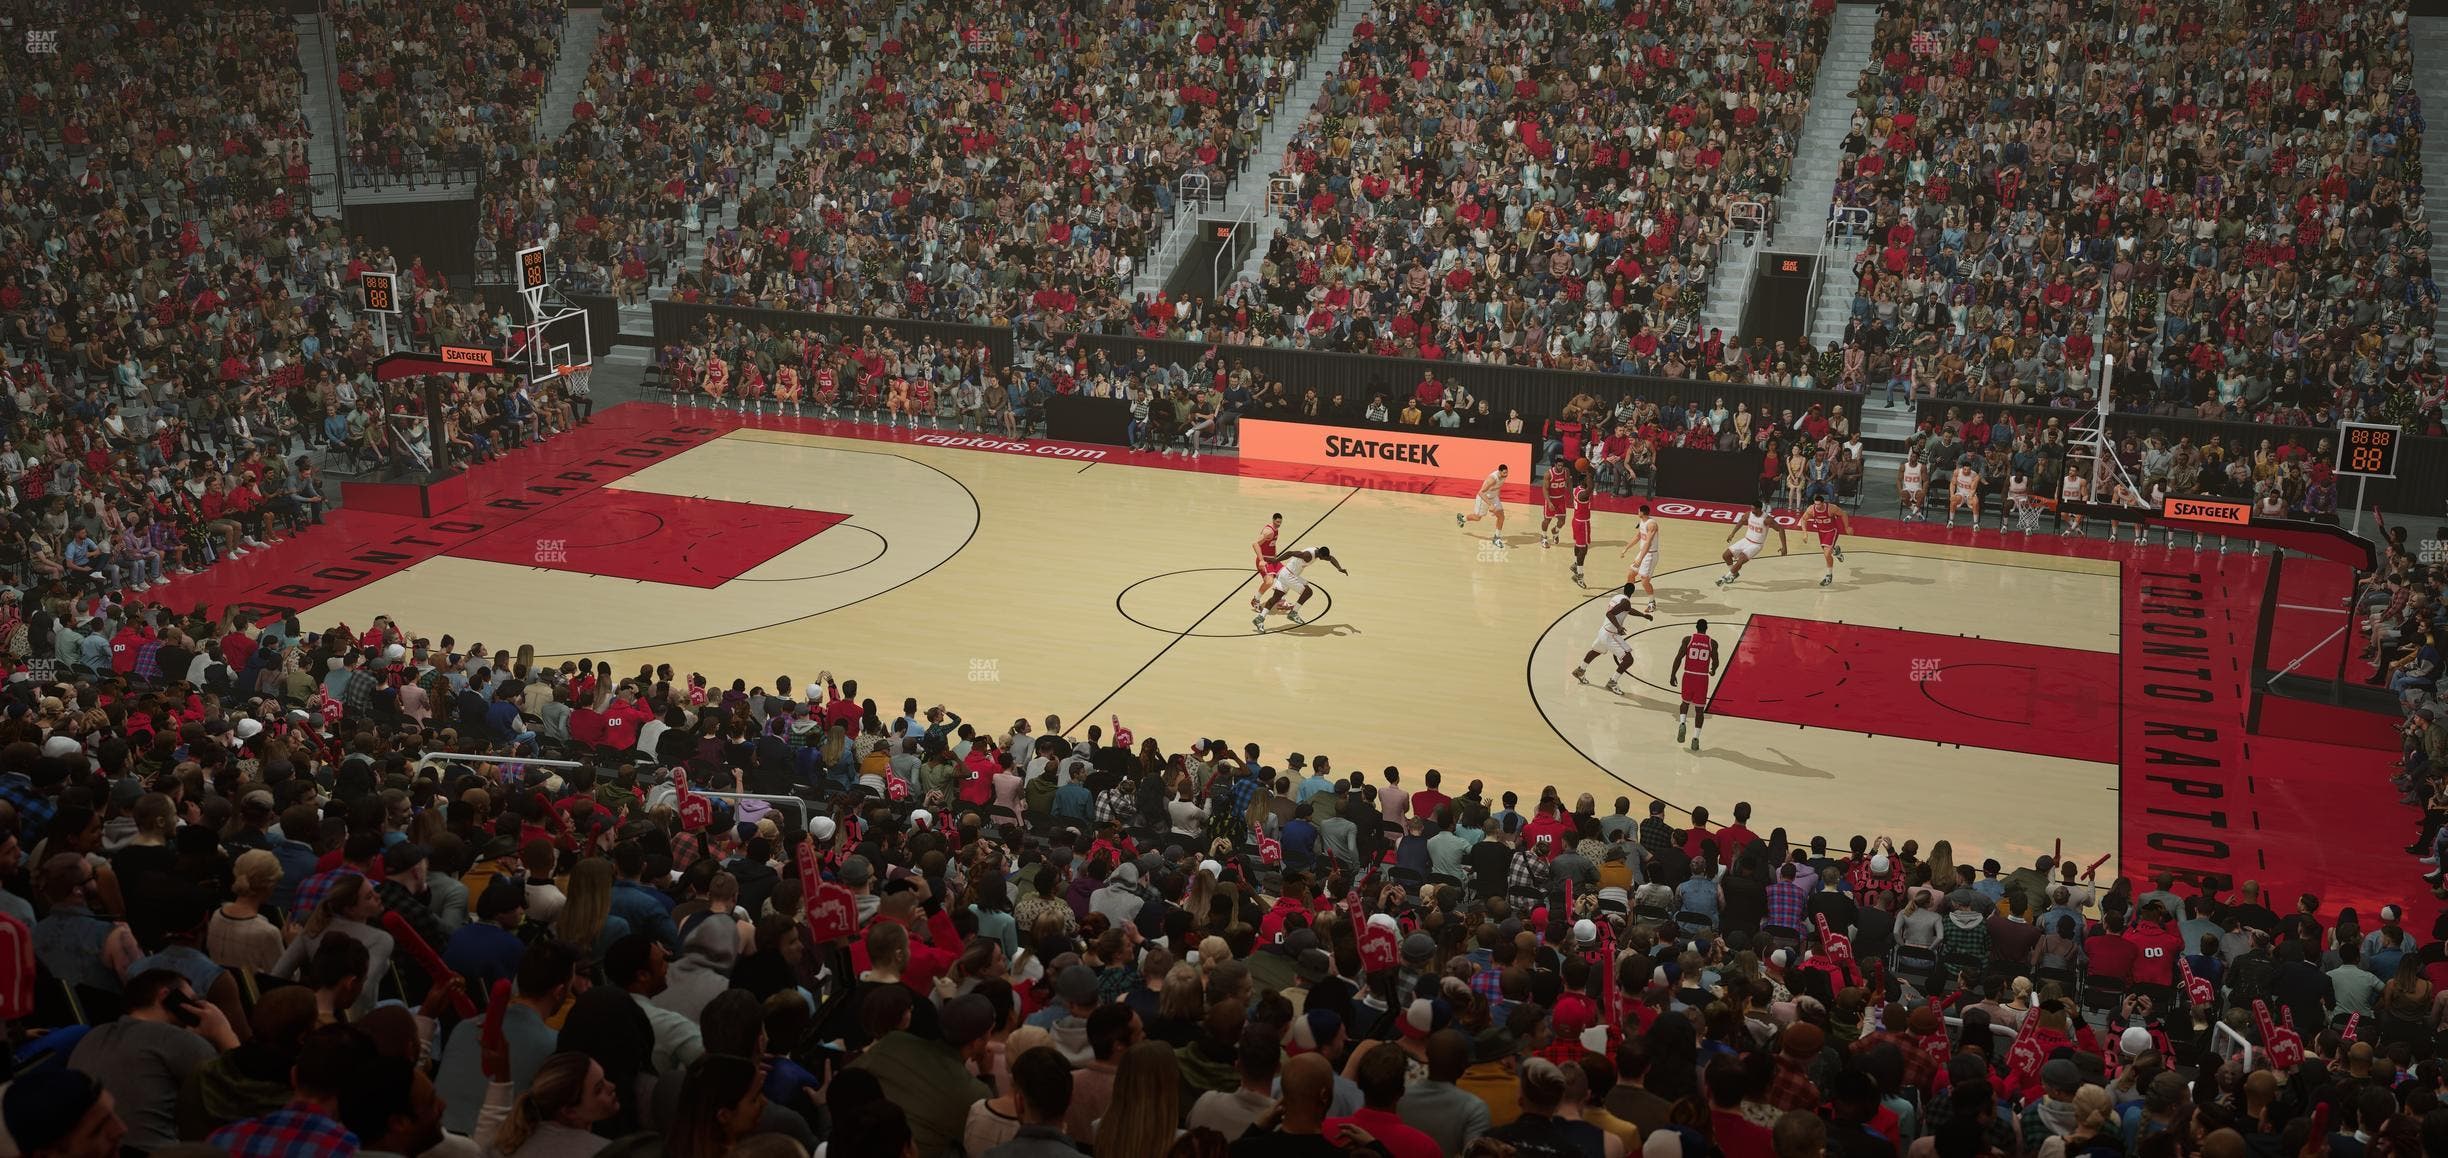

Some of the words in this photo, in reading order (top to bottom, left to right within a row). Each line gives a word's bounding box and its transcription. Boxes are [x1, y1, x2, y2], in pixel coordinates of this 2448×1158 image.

[528, 266, 541, 285] 88
[370, 290, 387, 308] 88
[446, 350, 487, 363] SEATGEEK
[914, 433, 1107, 459] raptors.com
[2352, 430, 2369, 443] 88
[2372, 432, 2389, 445] 88
[1325, 435, 1440, 467] SEATGEEK
[2352, 447, 2382, 471] 88
[486, 426, 716, 511] RAPTORS
[2174, 502, 2241, 520] SEATGEEK
[2141, 571, 2214, 703] TORONTO
[114, 644, 126, 652] 00
[1688, 648, 1710, 661] 00
[609, 717, 622, 727] 00
[2144, 947, 2164, 957] 00
